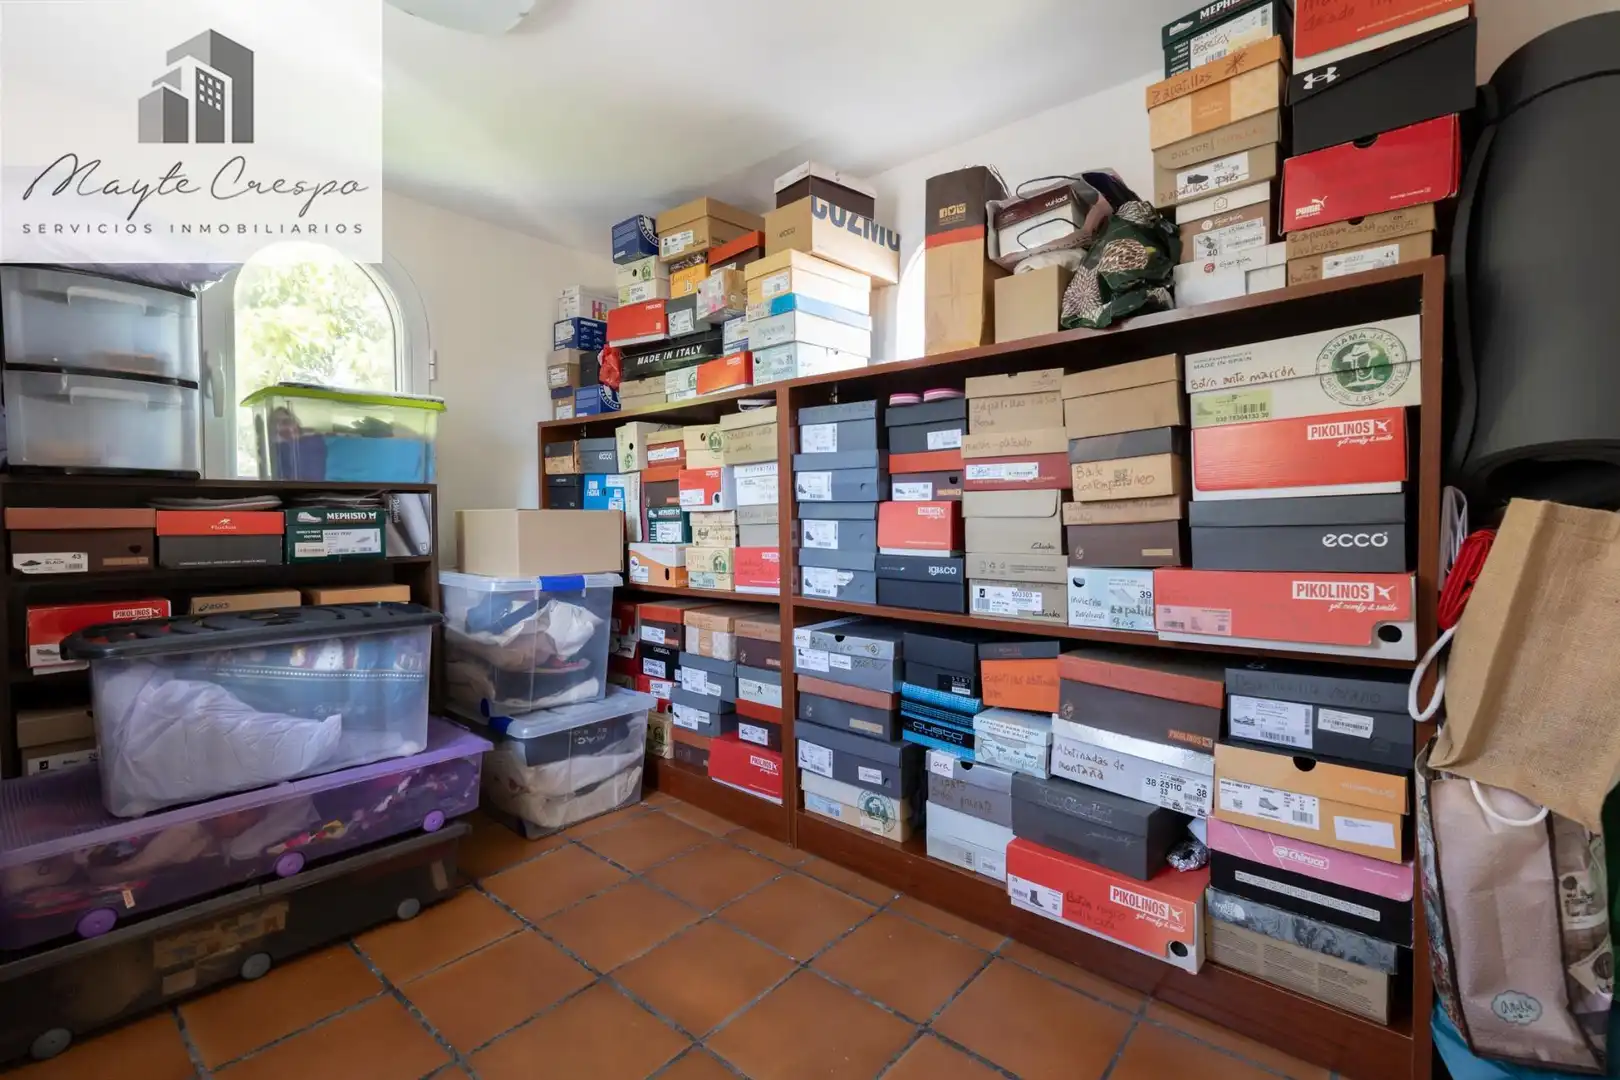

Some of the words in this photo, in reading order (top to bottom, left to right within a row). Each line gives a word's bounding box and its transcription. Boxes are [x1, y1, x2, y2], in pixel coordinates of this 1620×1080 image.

[637, 353, 660, 365] MADE
[663, 350, 674, 360] IN
[676, 344, 703, 357] ITALY
[1311, 421, 1370, 439] PIKOLINOS
[326, 511, 367, 520] MEPHISTO
[1321, 532, 1389, 548] ecco
[1139, 590, 1152, 599] 39
[1296, 583, 1370, 599] PIKOLINOS
[115, 609, 150, 618] PIKOLINOS
[1145, 776, 1157, 786] 38
[1159, 779, 1182, 792] 25110
[1196, 787, 1208, 798] 38
[1159, 787, 1169, 796] 33
[1113, 887, 1167, 917] PIKOLINOS
